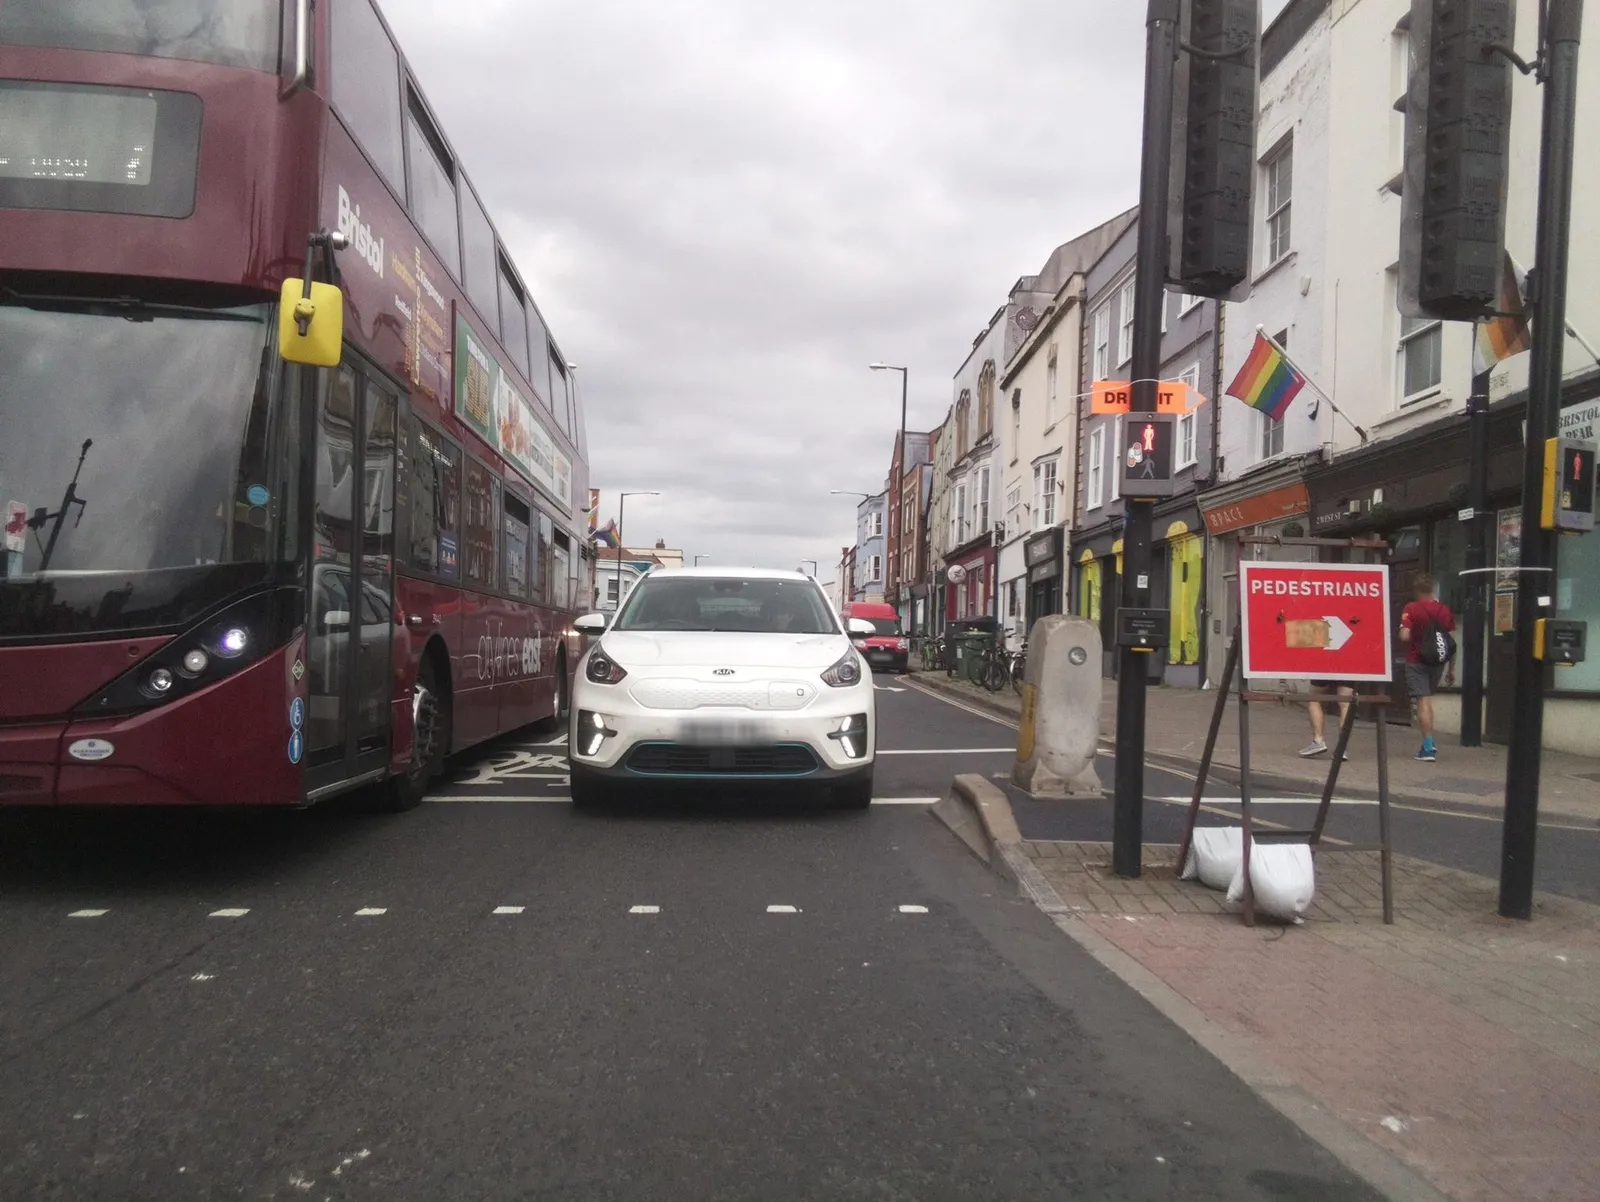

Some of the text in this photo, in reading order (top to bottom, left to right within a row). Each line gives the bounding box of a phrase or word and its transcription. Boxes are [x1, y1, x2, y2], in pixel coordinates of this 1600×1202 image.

[338, 183, 384, 279] Bristol
[1558, 406, 1600, 429] BRISTOL
[1251, 579, 1380, 598] PEDESTRIANS
[522, 630, 541, 674] east
[1436, 631, 1446, 662] adidas
[714, 668, 734, 676] KIA
